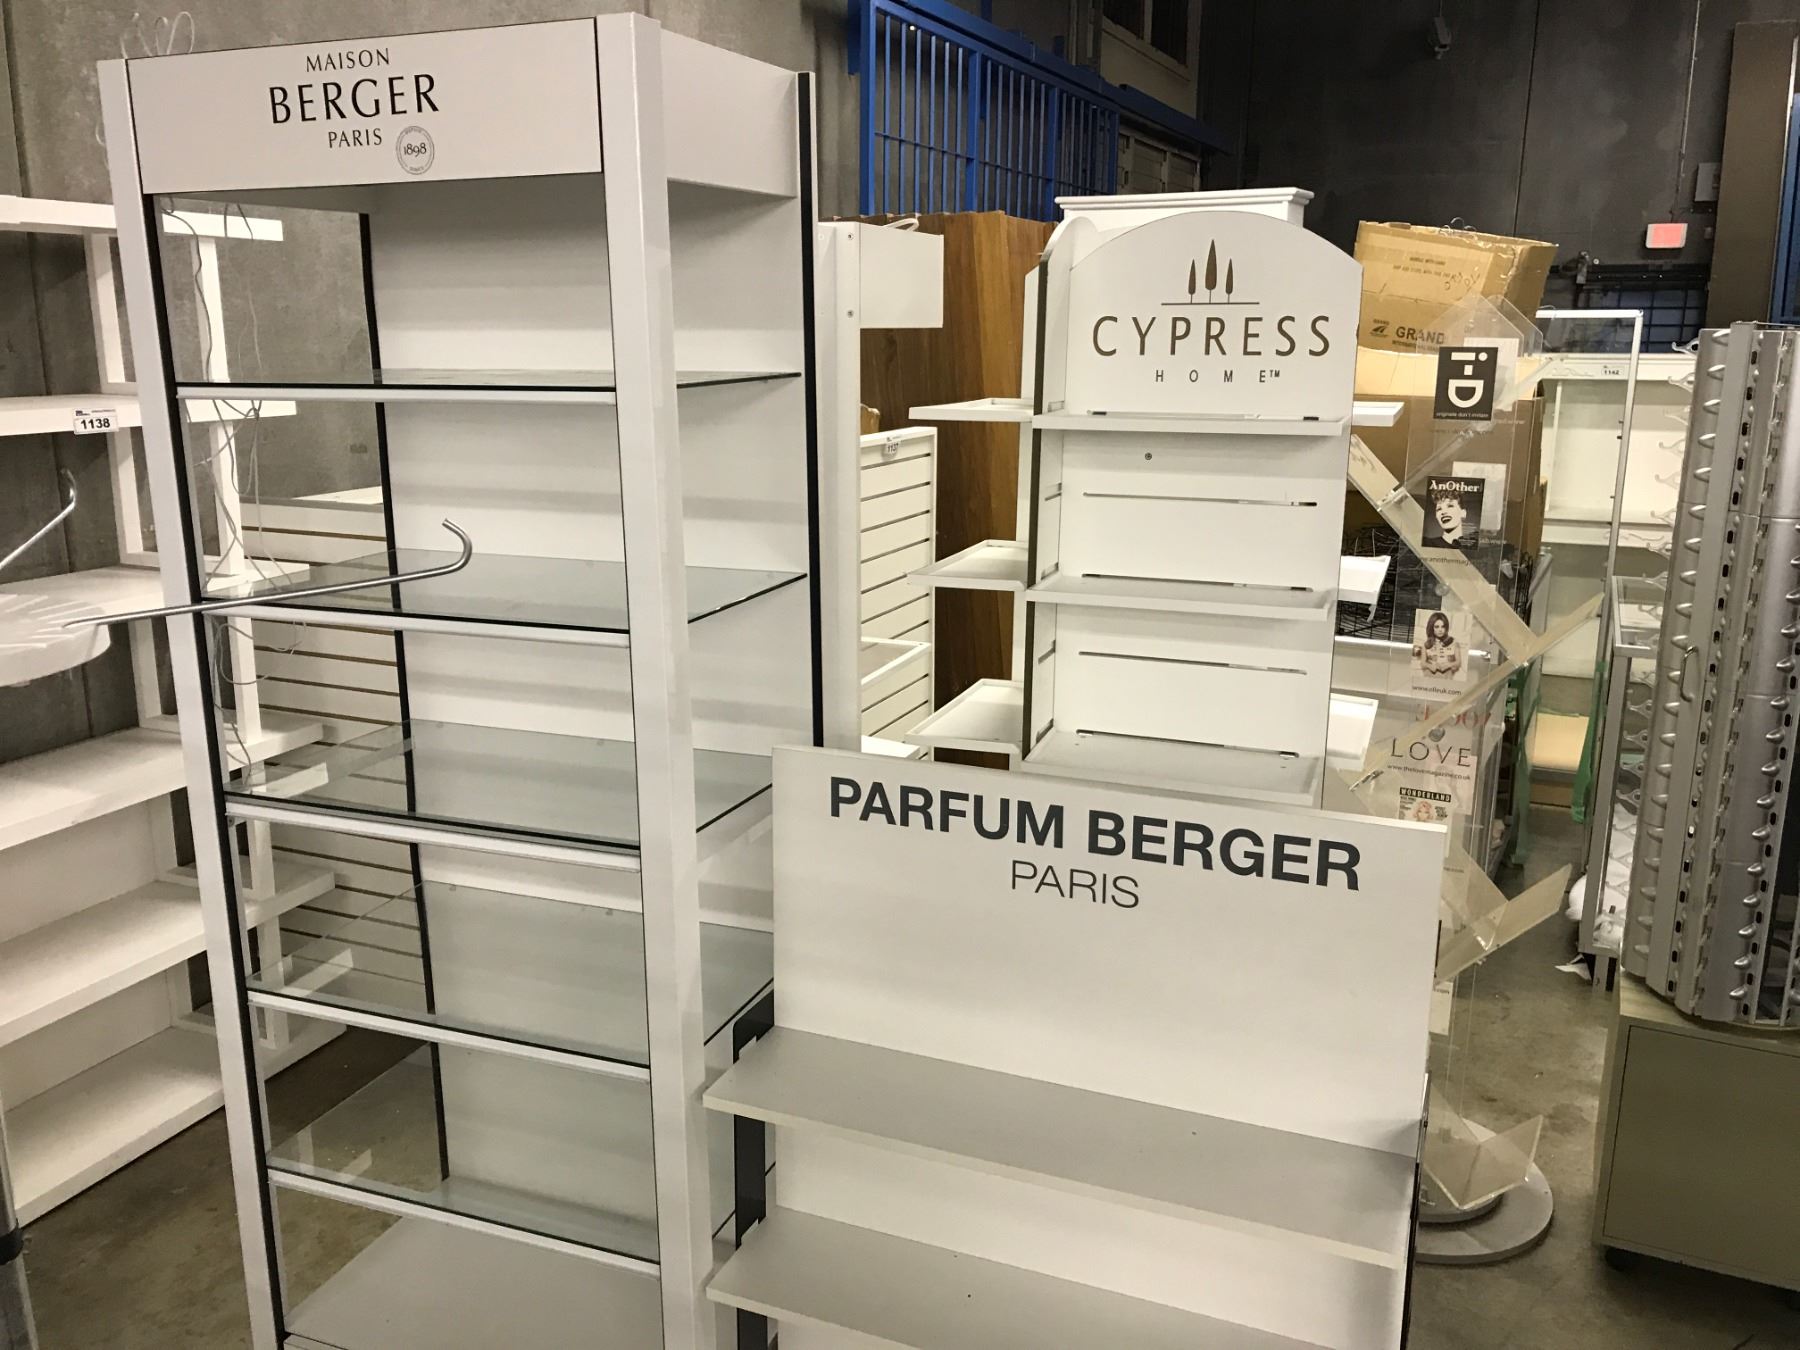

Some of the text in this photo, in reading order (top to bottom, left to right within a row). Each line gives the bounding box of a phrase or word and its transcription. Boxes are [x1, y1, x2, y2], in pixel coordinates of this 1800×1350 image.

[306, 47, 391, 74] MAISON
[269, 73, 440, 125] BERGER
[328, 127, 382, 149] PARIS
[403, 142, 428, 158] 1898
[1092, 315, 1331, 357] CYPRESS
[1395, 325, 1446, 346] GRAND
[80, 417, 111, 430] 1138
[1429, 479, 1480, 493] AnOther
[1390, 737, 1472, 768] LOVE
[1400, 787, 1451, 802] WONDERLAND
[829, 776, 1363, 892] PARFUM BERGER
[1011, 859, 1140, 910] PARIS
